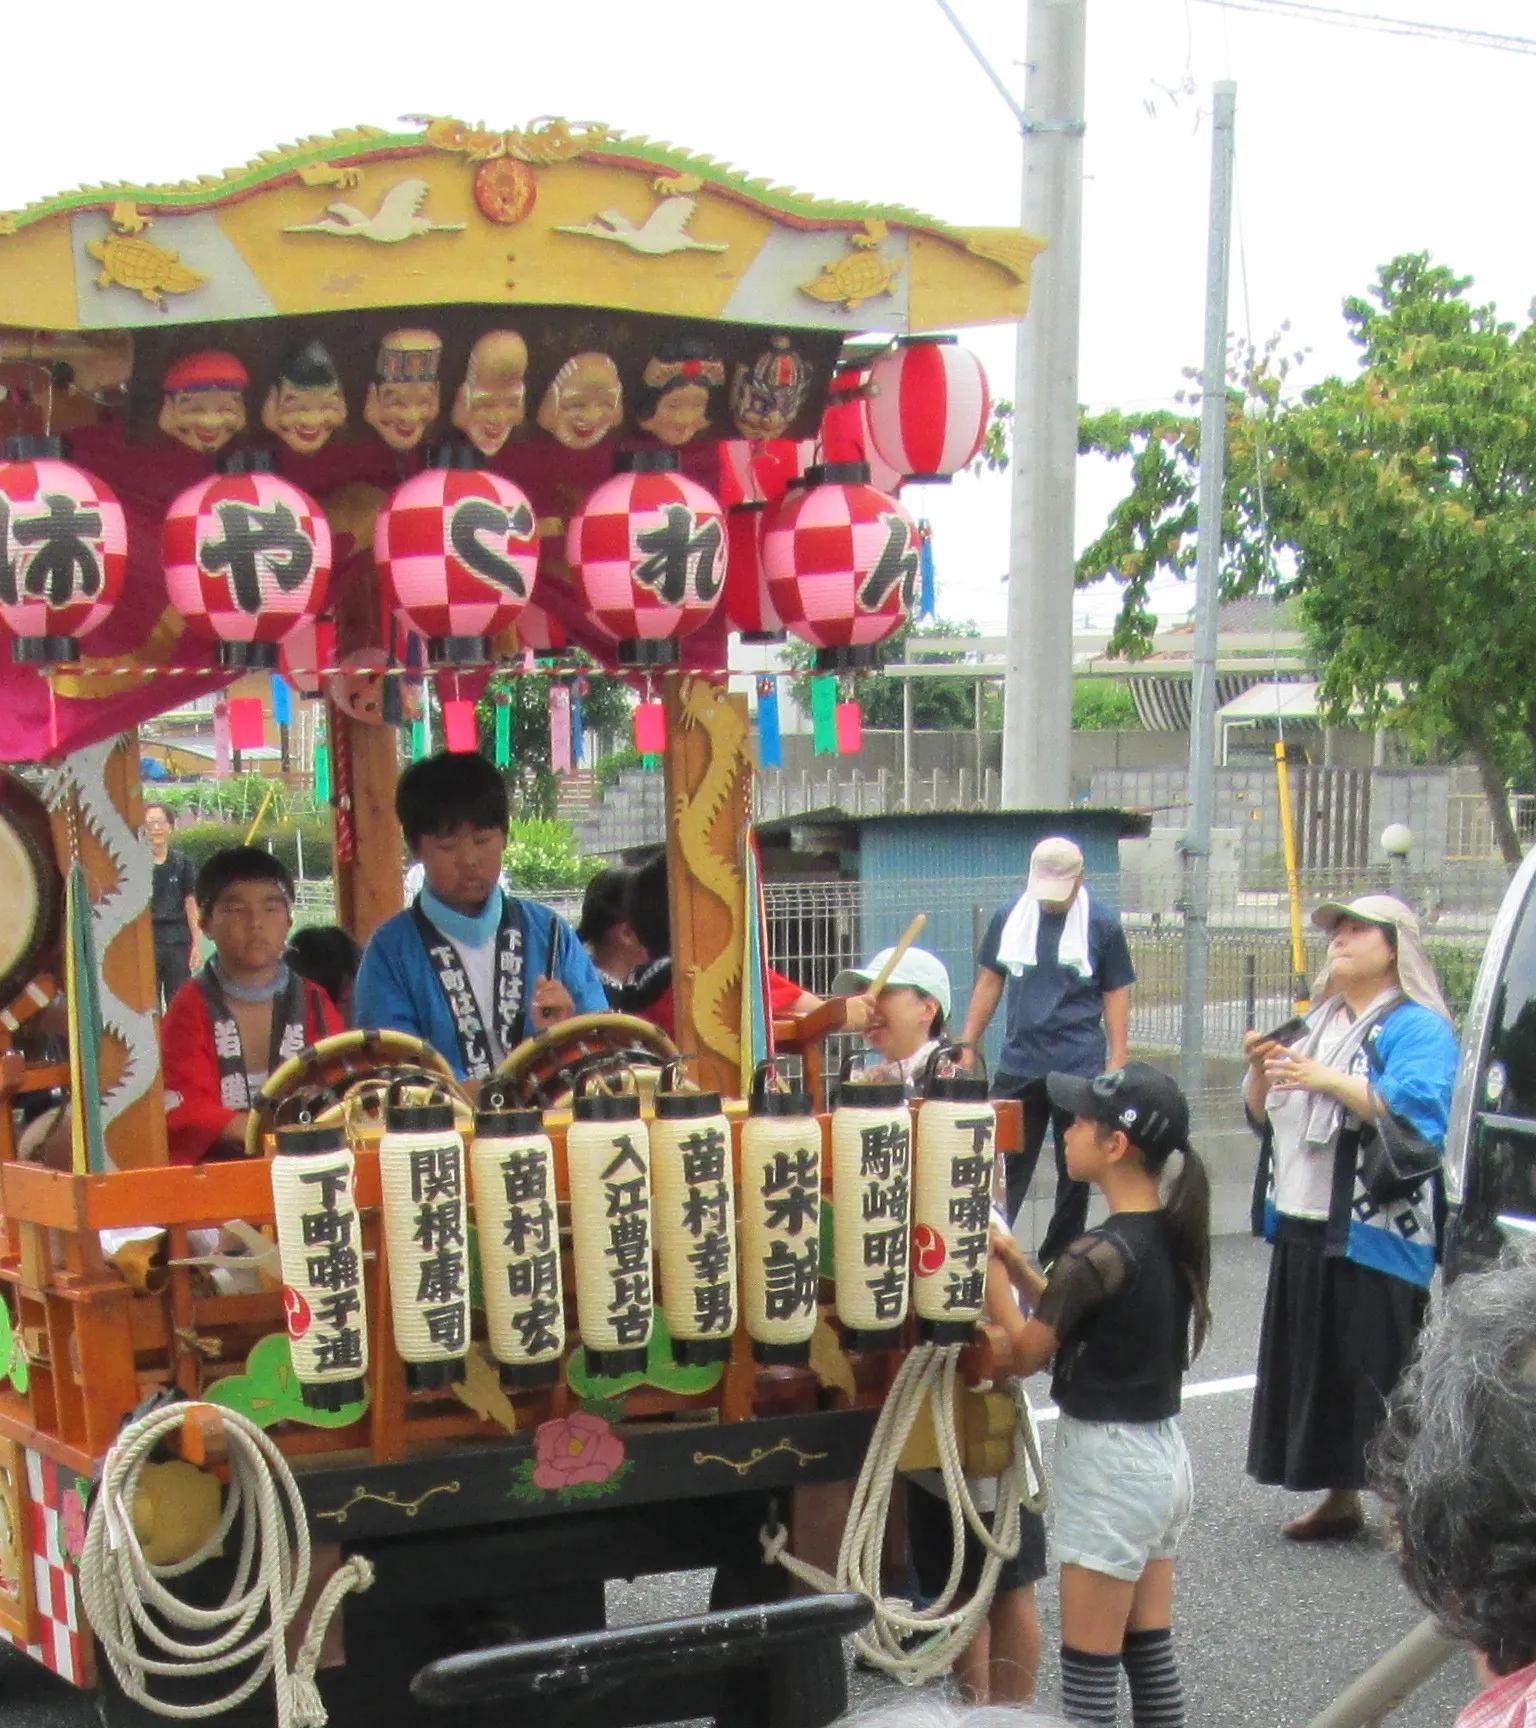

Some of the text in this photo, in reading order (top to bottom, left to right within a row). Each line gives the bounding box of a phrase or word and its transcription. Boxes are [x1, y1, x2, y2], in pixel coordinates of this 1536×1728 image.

[299, 1164, 362, 1374] 下町囃子連
[409, 1146, 463, 1352] 関根康司
[500, 1149, 562, 1357] 苗村明宏
[599, 1137, 651, 1347] 入江豊比古
[677, 1128, 735, 1334] 苗村幸男
